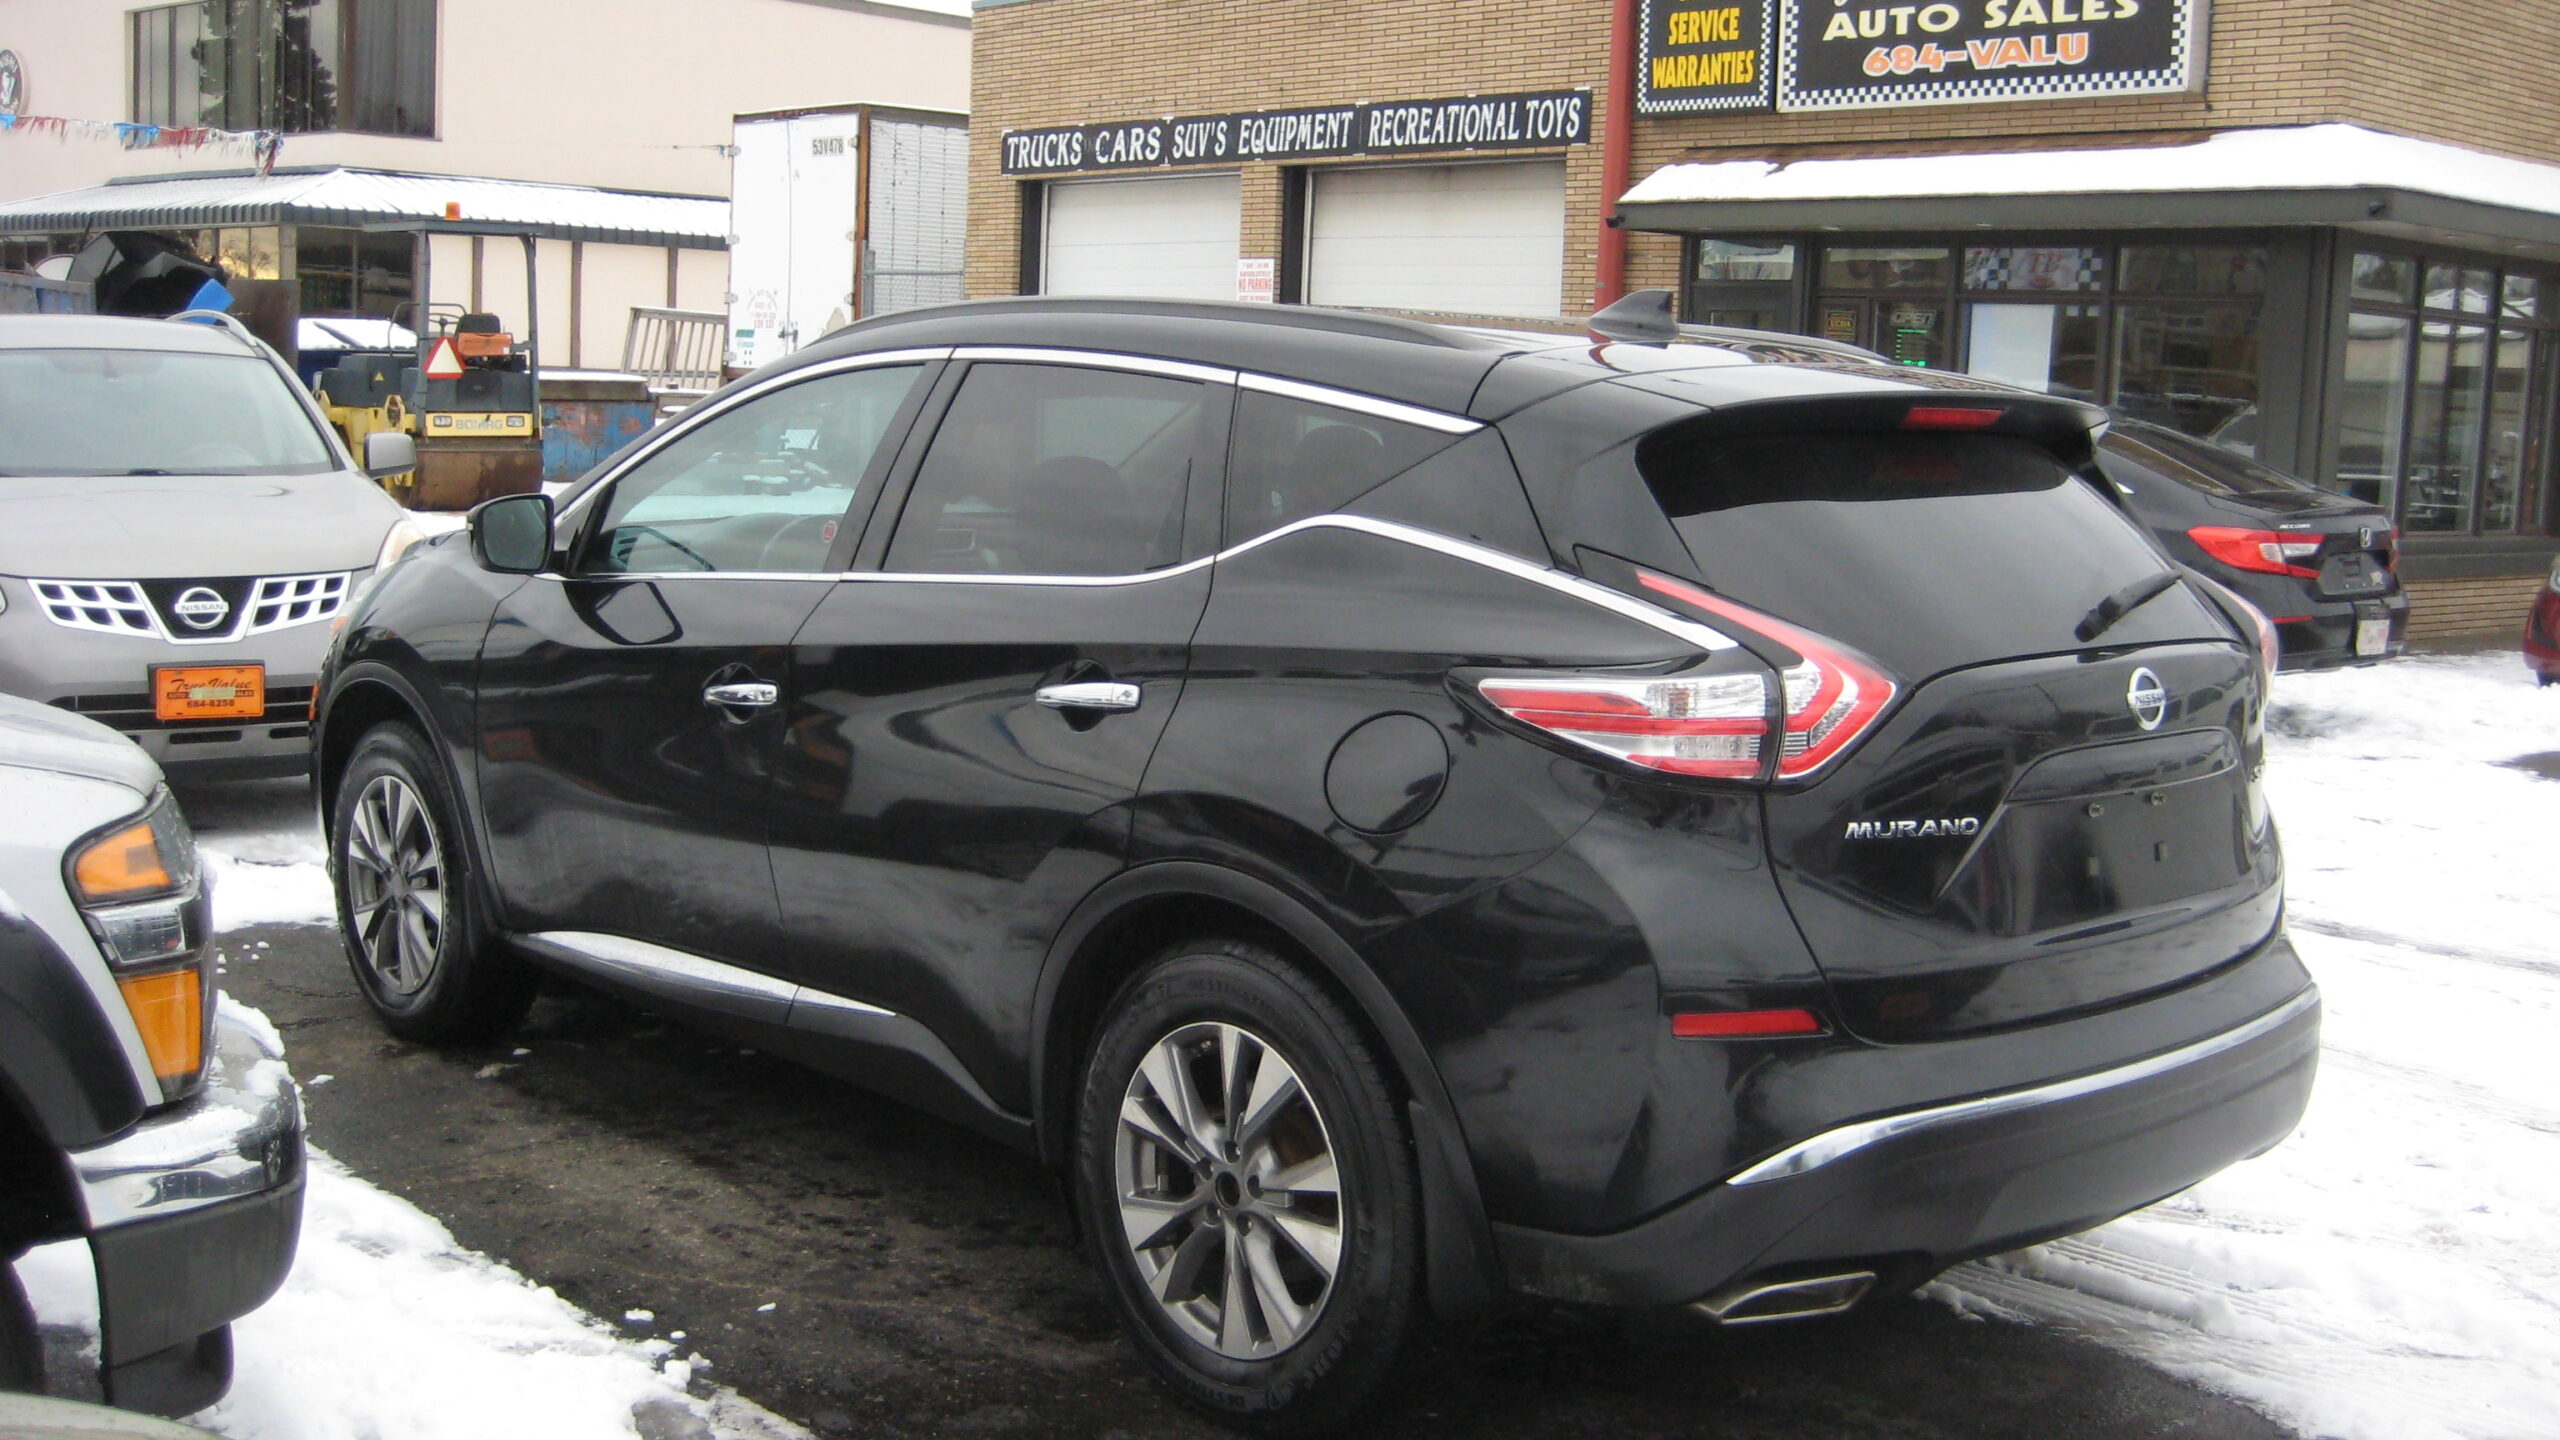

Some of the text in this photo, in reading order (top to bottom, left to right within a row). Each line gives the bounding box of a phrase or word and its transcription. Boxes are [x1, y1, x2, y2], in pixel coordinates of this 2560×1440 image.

[1668, 7, 1740, 46] SERVICE
[1822, 0, 2139, 41] AUTO SALES
[1652, 49, 1755, 89] WARRANTIES
[1862, 32, 2089, 77] 684-VALU
[1007, 97, 1582, 169] TRUCKS CARS SUV'S EQUIPMENT RECREATIONAL TOYS
[1248, 278, 1272, 290] PARKING
[1893, 311, 1933, 325] OPEN
[181, 603, 224, 612] NISSAN
[1844, 816, 1979, 840] MURANO
